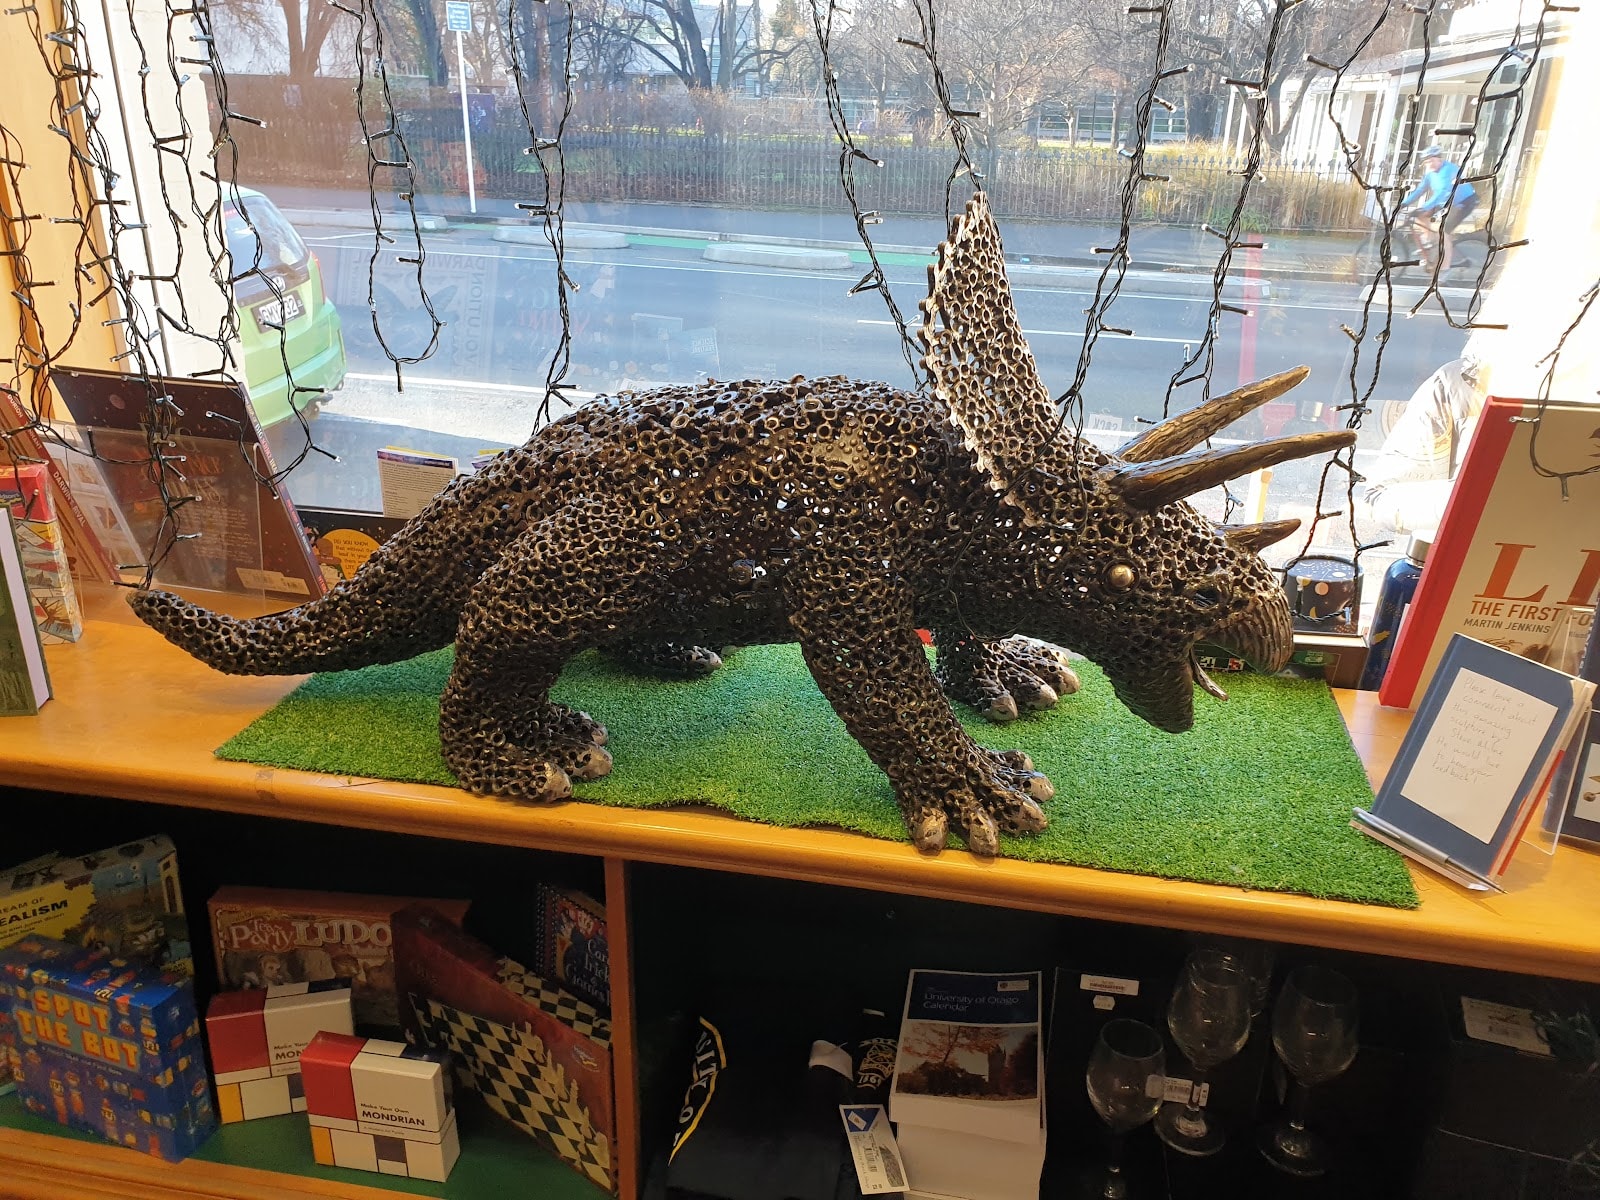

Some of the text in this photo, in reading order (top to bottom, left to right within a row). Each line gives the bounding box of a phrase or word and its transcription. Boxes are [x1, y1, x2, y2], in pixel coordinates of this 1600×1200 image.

[261, 297, 298, 323] GMY32
[22, 421, 44, 451] TNNANT
[254, 423, 264, 438] BIG
[71, 505, 89, 528] RIVAL
[1470, 601, 1504, 617] THE
[1507, 604, 1563, 621] FIRST
[1464, 618, 1552, 633] MARTIN JENKINS
[1463, 695, 1538, 726] comment about
[1449, 716, 1486, 736] sculpture
[1474, 714, 1512, 739] amazing
[31, 896, 46, 906] OF
[230, 919, 392, 952] Party LUDO
[923, 1001, 969, 1012] Calendar
[924, 993, 973, 1004] University
[988, 996, 1019, 1006] Otago
[34, 989, 109, 1032] SPOT
[16, 1008, 71, 1048] THE
[82, 1030, 138, 1069] BOT
[362, 1111, 425, 1126] MONDRIAN
